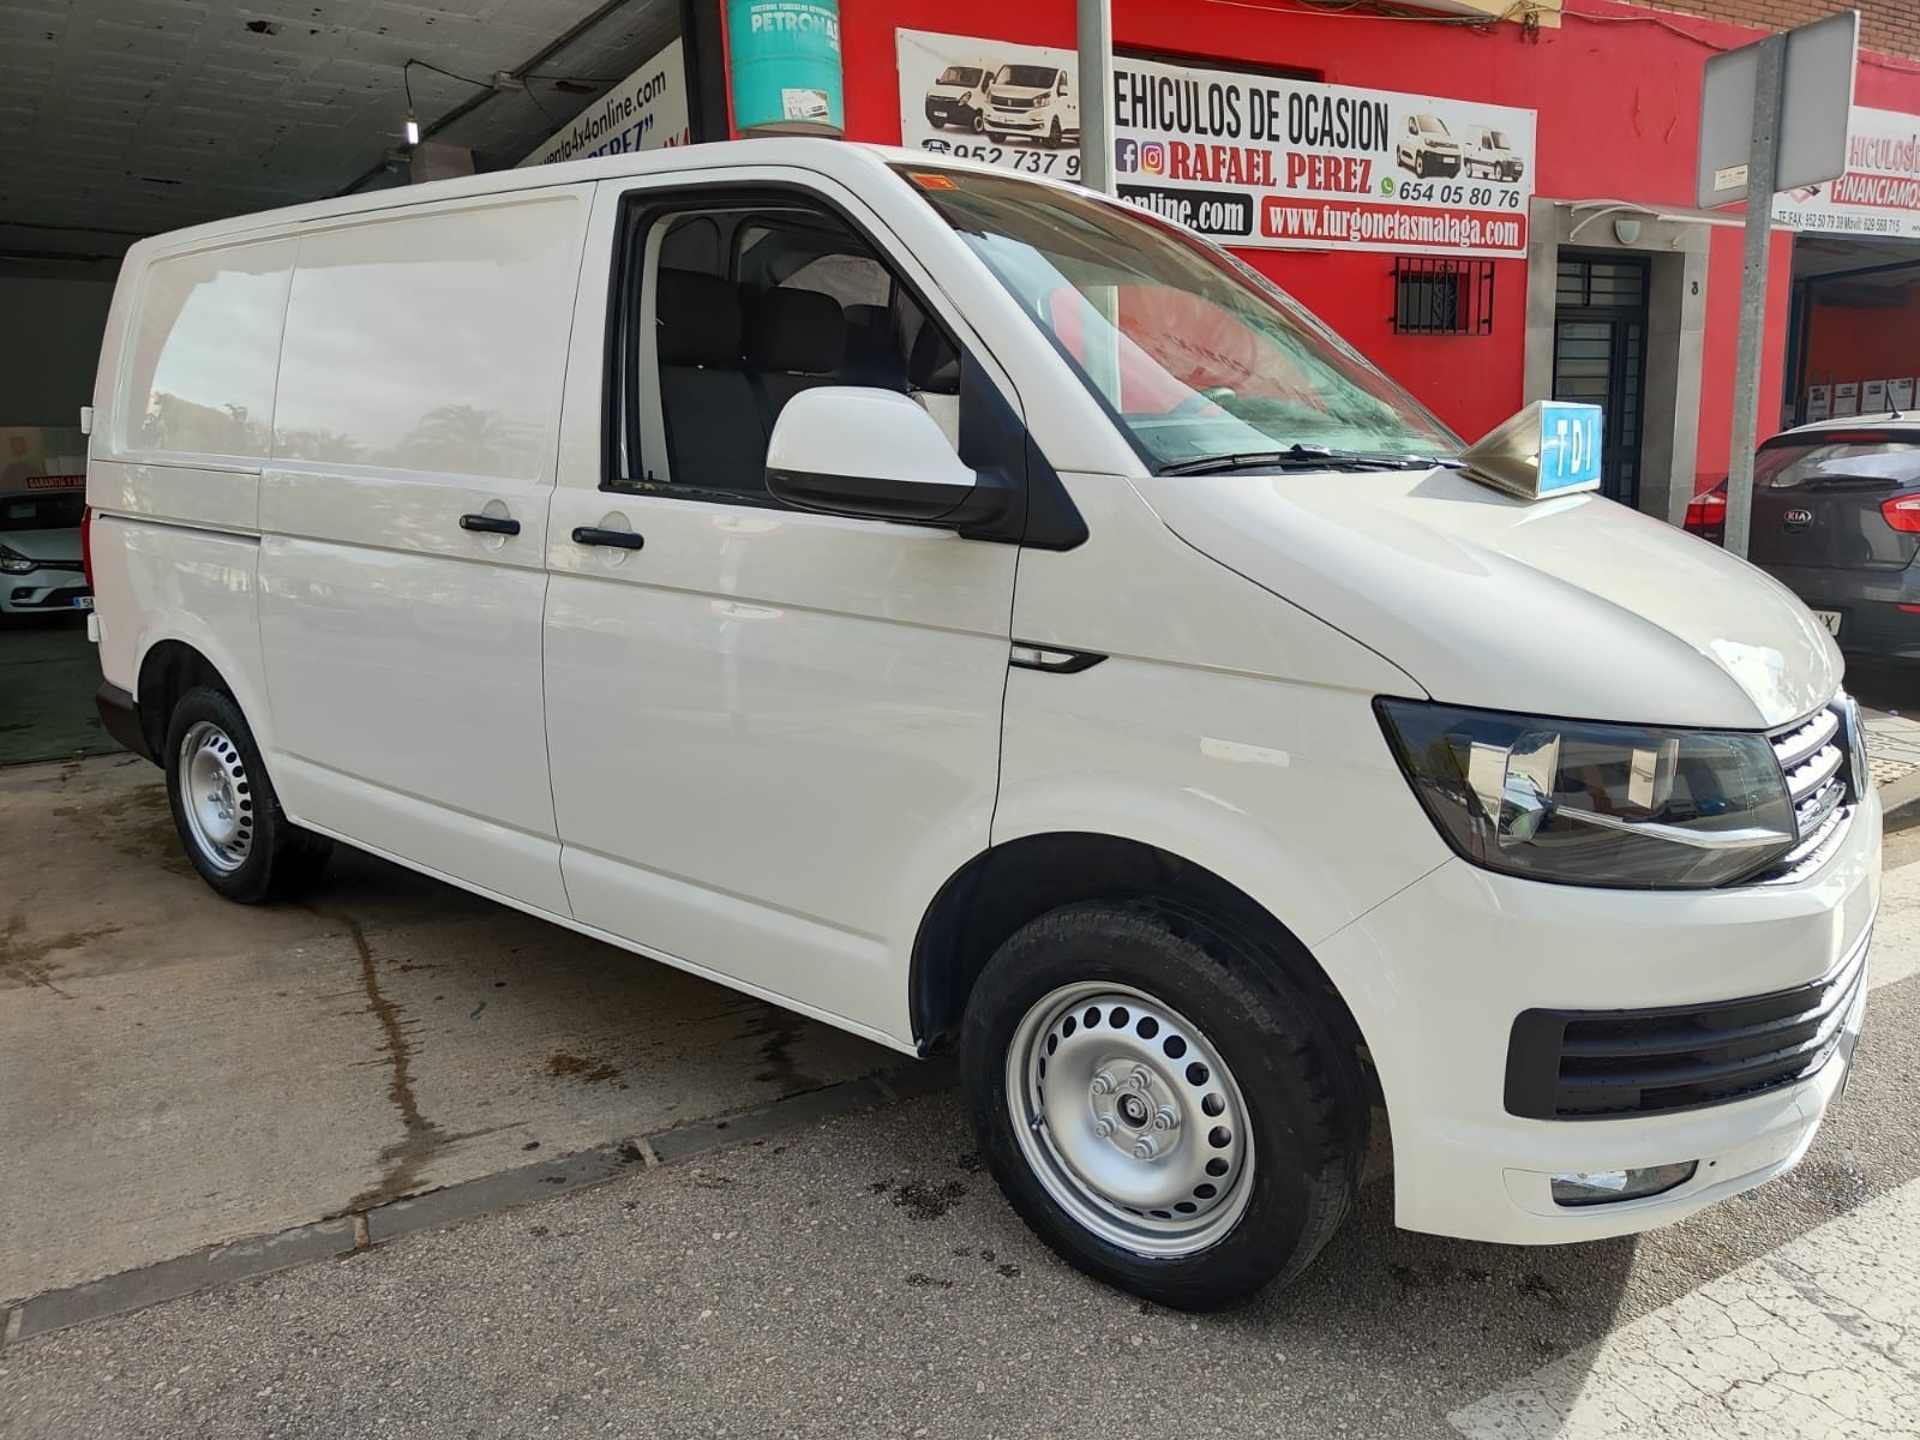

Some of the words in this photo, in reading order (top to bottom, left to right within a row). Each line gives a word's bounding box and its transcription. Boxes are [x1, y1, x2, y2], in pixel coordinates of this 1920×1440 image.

[539, 71, 666, 165] venta4x4online.com
[1113, 70, 1242, 139] EHICULOS
[1250, 88, 1280, 142] DE
[1288, 91, 1389, 152] OCASION
[1013, 150, 1058, 174] 737
[1168, 140, 1277, 187] RAFAEL
[1286, 151, 1372, 194] PEREZ
[1849, 134, 1913, 172] HICULOS
[1400, 181, 1434, 201] 654
[1441, 185, 1463, 204] 05
[1469, 188, 1492, 206] 80
[1498, 190, 1520, 208] 76
[1269, 204, 1519, 248] www.furgonetasmalaga.com
[1691, 281, 1699, 295] 3
[1557, 418, 1592, 477] TDI
[1787, 511, 1807, 522] KIA
